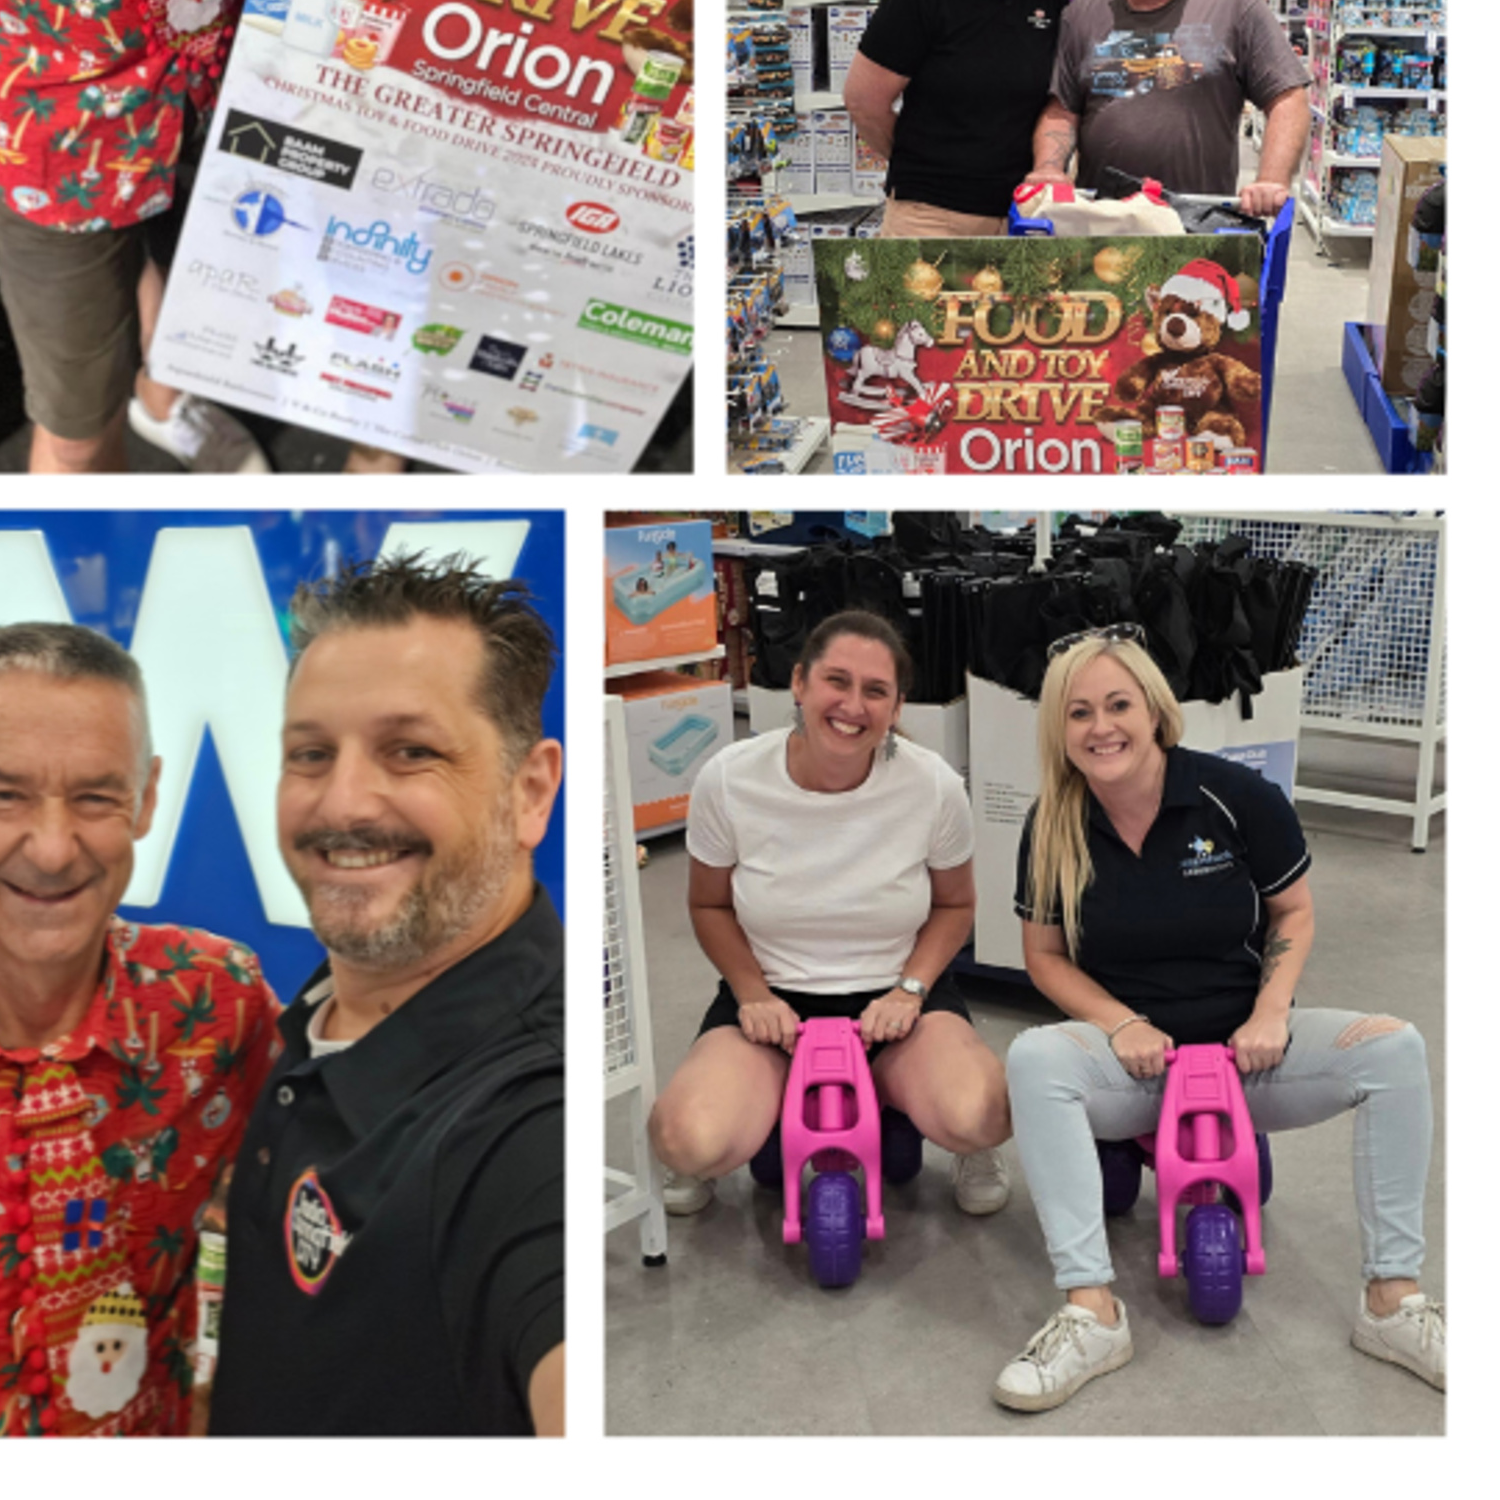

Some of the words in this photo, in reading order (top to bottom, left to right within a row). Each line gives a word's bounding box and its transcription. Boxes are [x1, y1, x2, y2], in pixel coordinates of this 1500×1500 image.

[421, 1, 616, 106] Orion
[411, 58, 522, 107] Springfield
[523, 93, 599, 130] Central
[262, 75, 352, 114] CHRISTMAS
[402, 116, 450, 142] FOOD
[451, 133, 501, 157] DRIVE
[540, 160, 617, 193] PROUDLY
[315, 63, 371, 98] THE
[374, 83, 497, 138] GREATER
[500, 122, 682, 190] SPRINGFIELD
[569, 204, 618, 231] IGA
[601, 242, 645, 266] LAKES
[936, 290, 1124, 347] FOOD
[954, 348, 1036, 380] AND
[1040, 348, 1110, 379] TOY
[959, 426, 1102, 473] Orion
